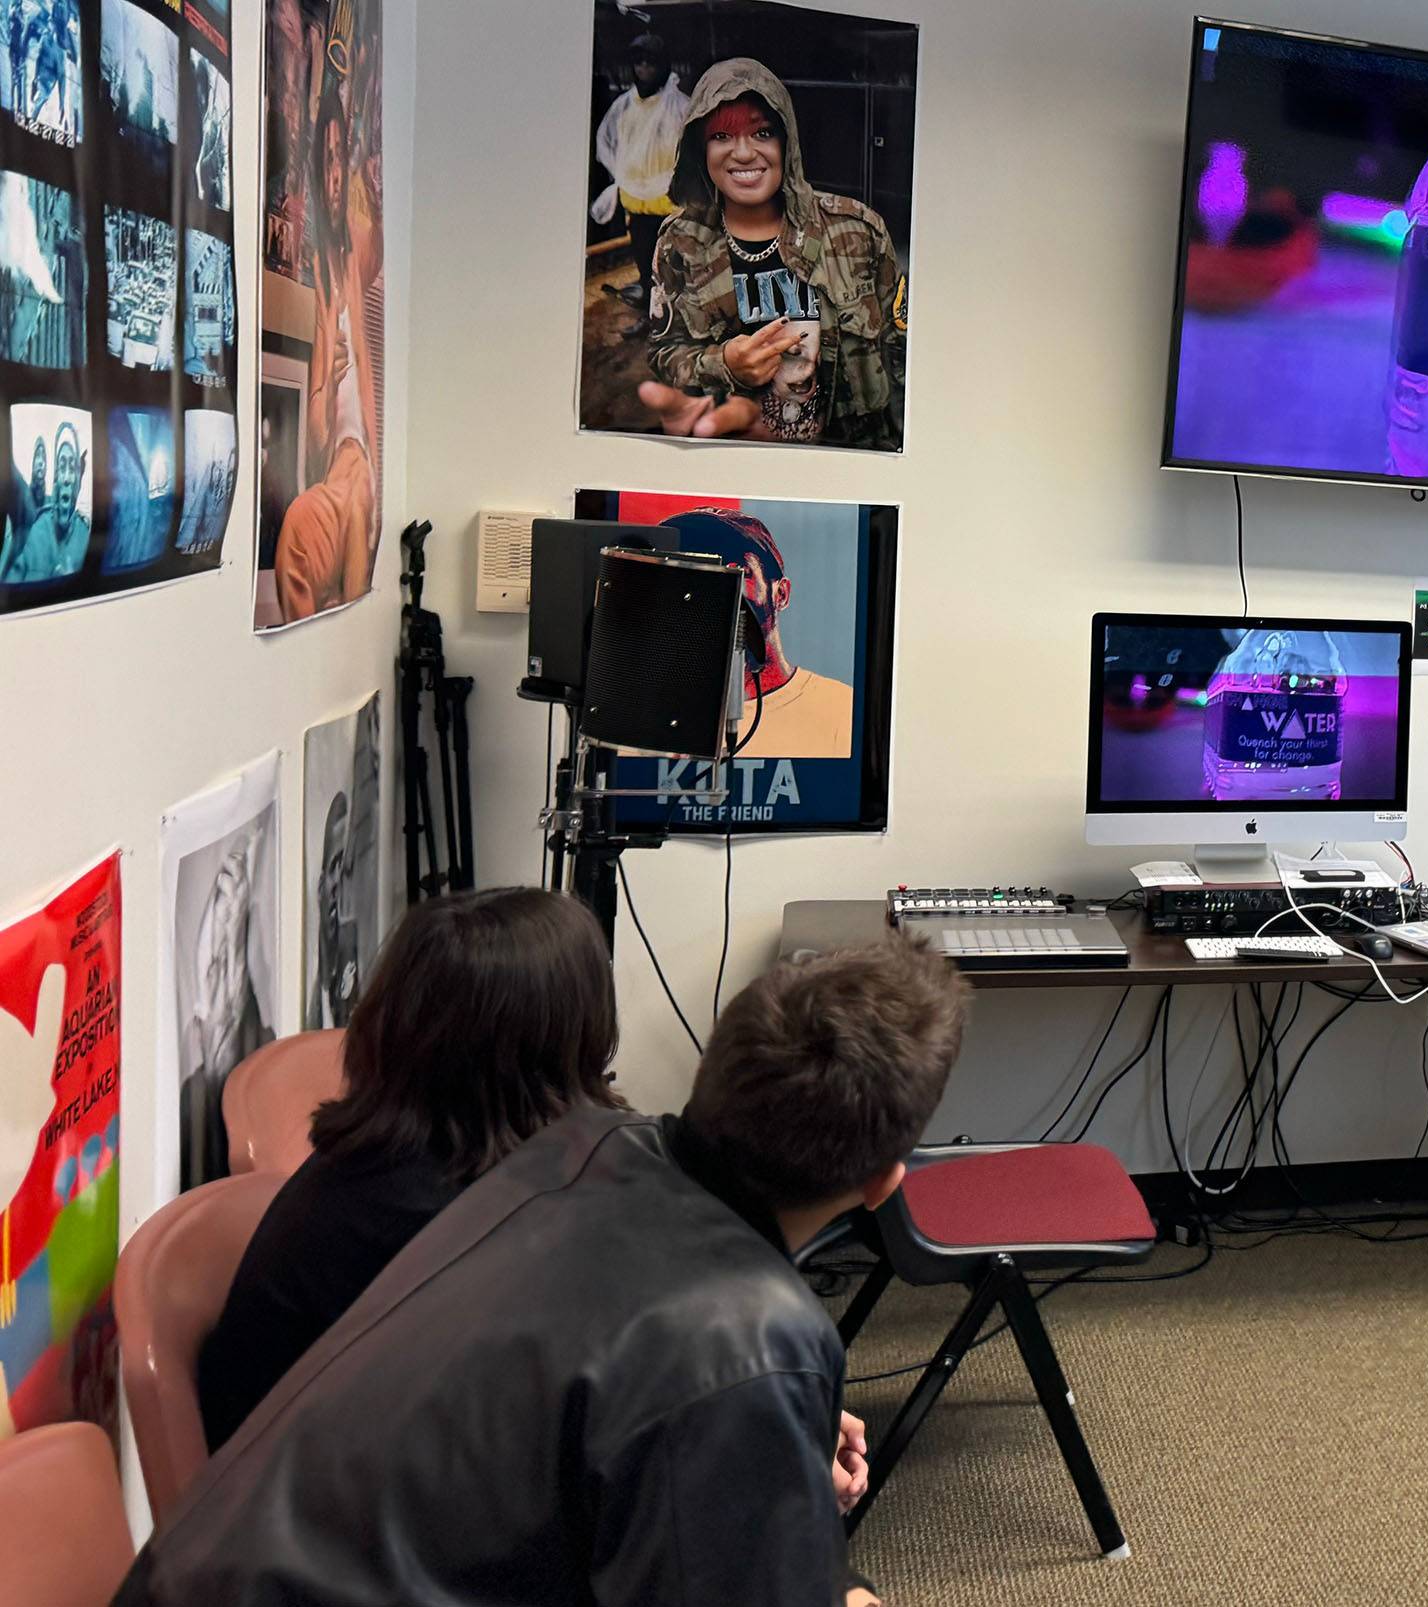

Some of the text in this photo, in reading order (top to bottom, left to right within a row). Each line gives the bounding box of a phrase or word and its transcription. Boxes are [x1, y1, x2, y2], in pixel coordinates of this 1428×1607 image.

[1260, 708, 1336, 739] WATER
[1238, 735, 1277, 749] Quench
[1280, 740, 1303, 751] your
[1254, 747, 1269, 759] for
[657, 758, 801, 805] KOTA
[682, 806, 774, 821] THE FRIEND
[86, 963, 100, 997] AN
[44, 1096, 81, 1151] WHITE
